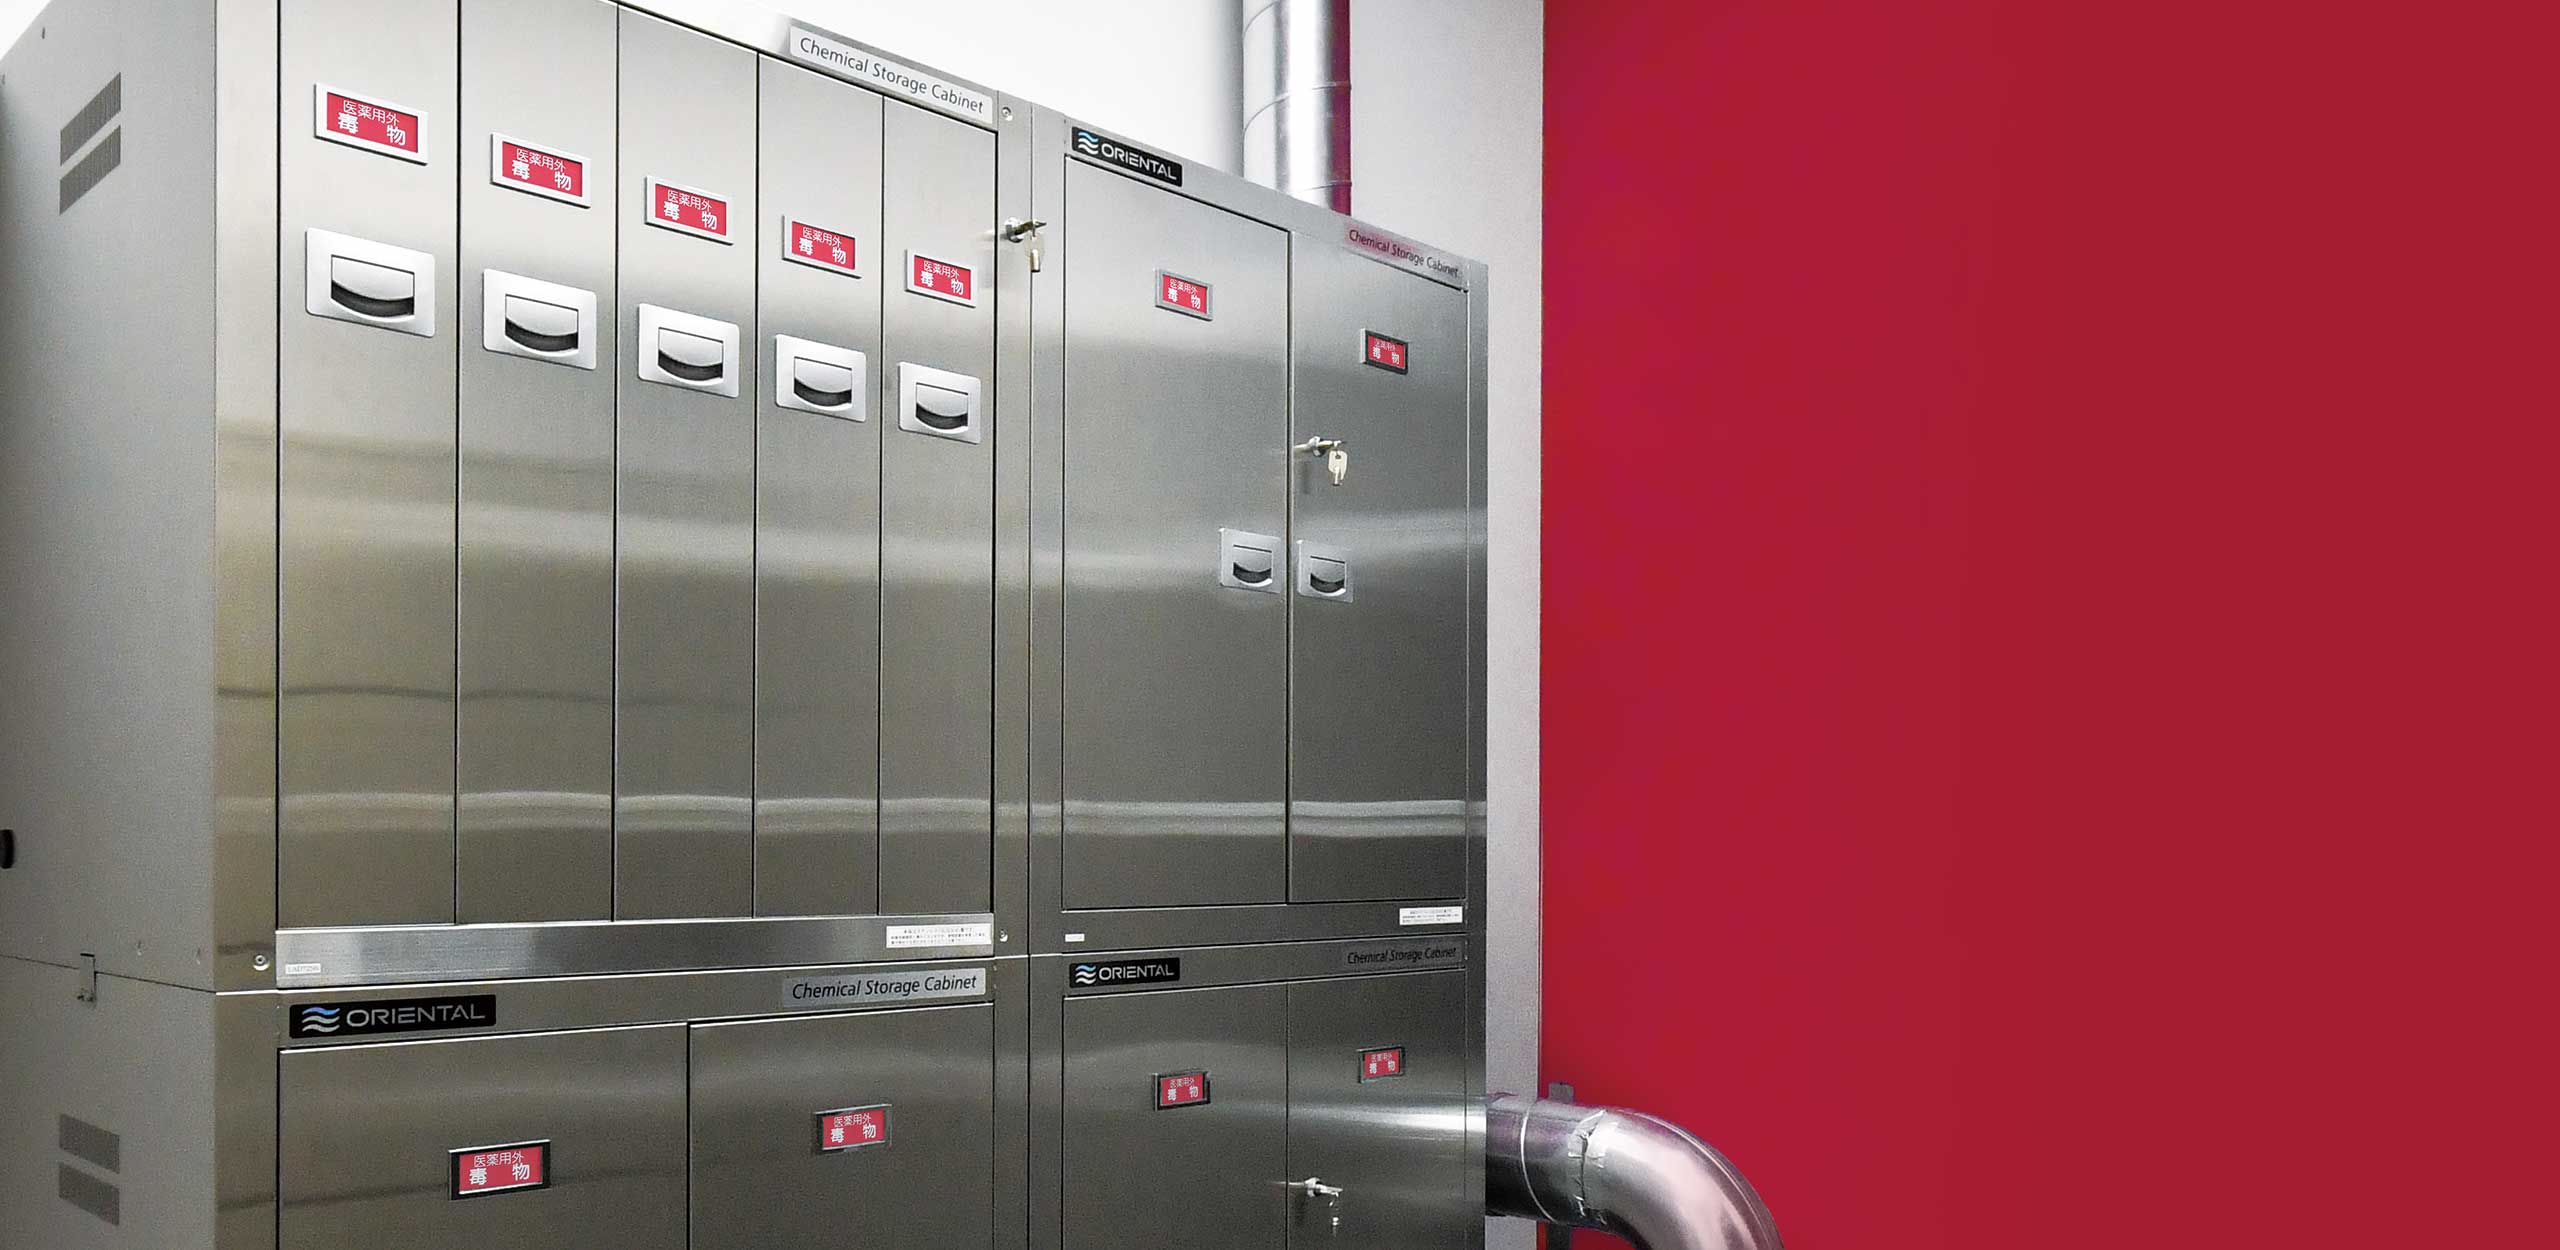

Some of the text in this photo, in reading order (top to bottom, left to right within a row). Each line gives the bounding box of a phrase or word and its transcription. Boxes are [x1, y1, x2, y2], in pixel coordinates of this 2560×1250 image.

[800, 37, 984, 114] Chemical Storage Cabinet
[343, 99, 400, 126] 医薬用外
[516, 148, 566, 173] 医薬用外
[1101, 143, 1177, 180] ORIENTAL
[667, 189, 712, 212] 医薬用外
[1349, 229, 1459, 278] Chemical Storage Cabinet
[1098, 964, 1174, 981] ORIENTAL
[792, 975, 977, 1000] Chemical Storage Cabinet
[346, 1003, 486, 1027] ORIENTAL
[474, 1152, 524, 1168] 医薬用外
